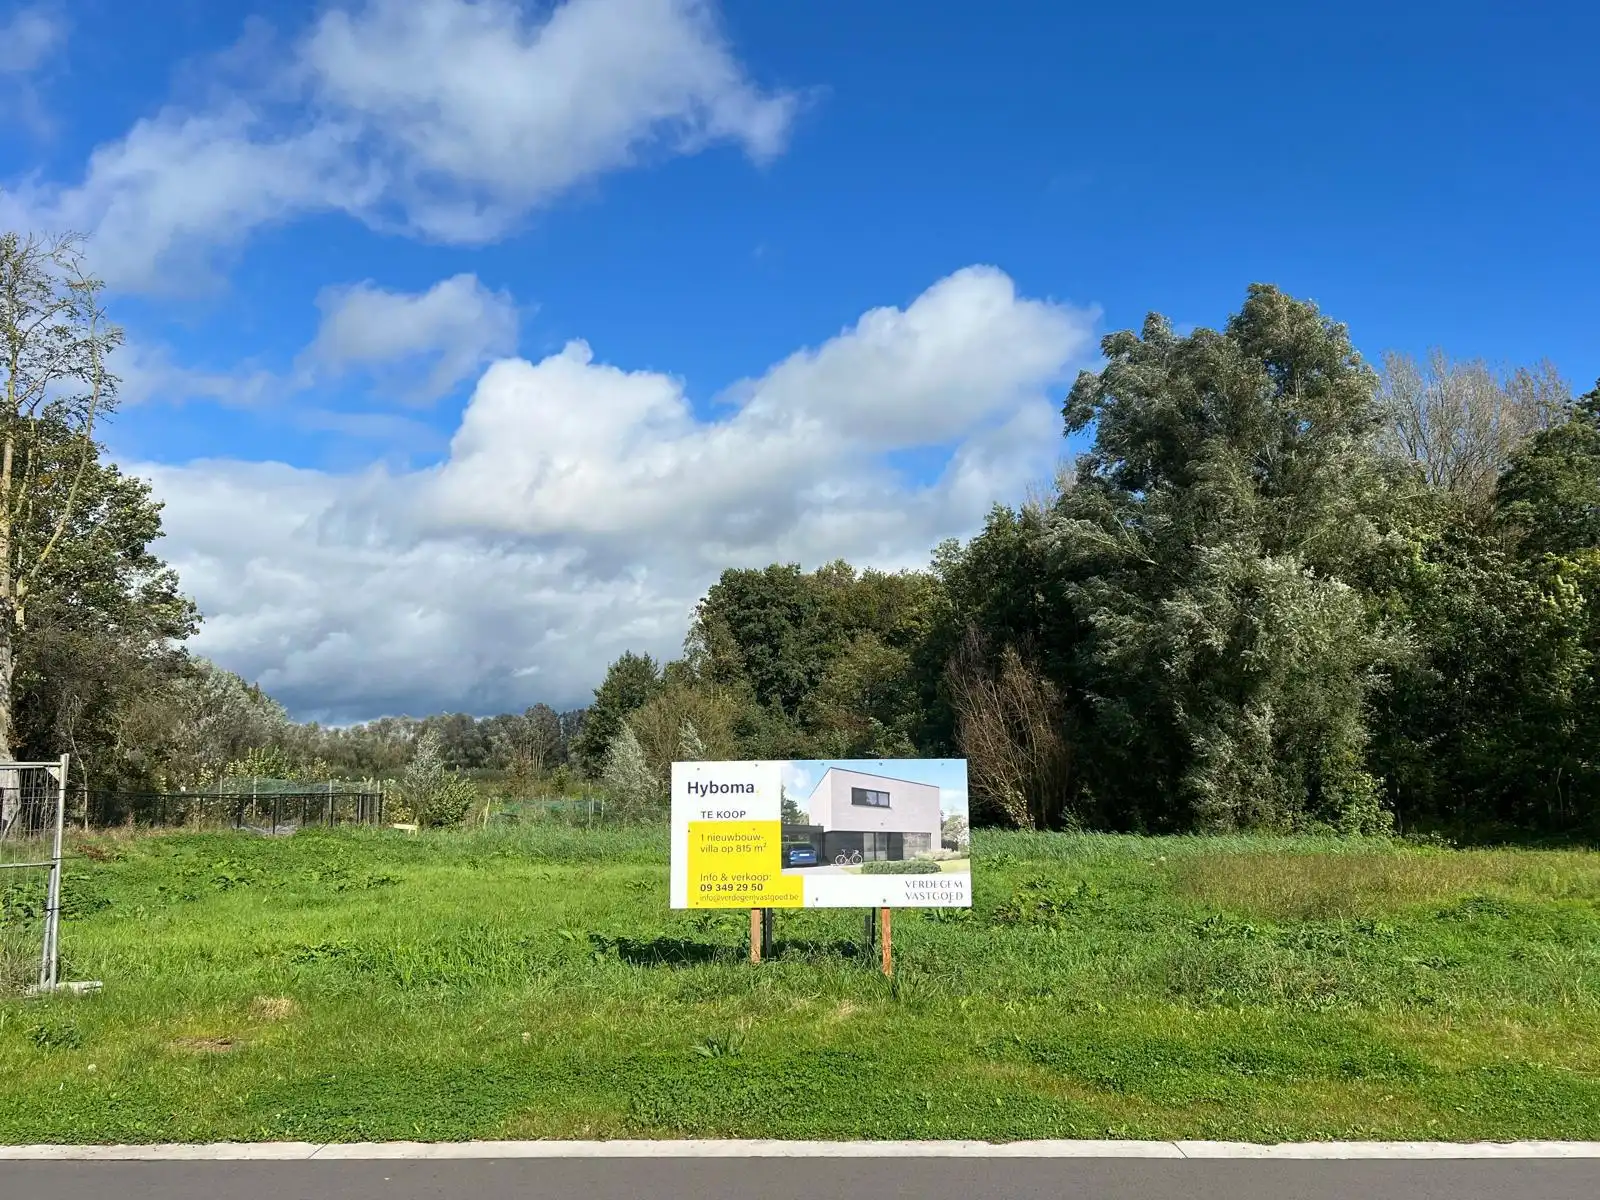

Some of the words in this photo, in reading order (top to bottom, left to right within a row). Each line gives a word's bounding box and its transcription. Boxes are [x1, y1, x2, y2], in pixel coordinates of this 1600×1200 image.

[701, 810, 713, 819] TE
[716, 810, 746, 819] KOOP
[707, 833, 764, 842] nieuwbouw-
[700, 844, 719, 853] villa
[721, 846, 734, 855] op
[736, 844, 752, 853] 815
[700, 873, 718, 882] Info
[720, 873, 729, 882] &
[731, 873, 772, 883] verkoop:
[700, 883, 713, 892] 09
[715, 883, 734, 892] 349
[736, 883, 749, 892] 29
[751, 883, 764, 892] 50
[904, 880, 963, 889] VERDEGEM
[905, 891, 963, 900] VASTGOED
